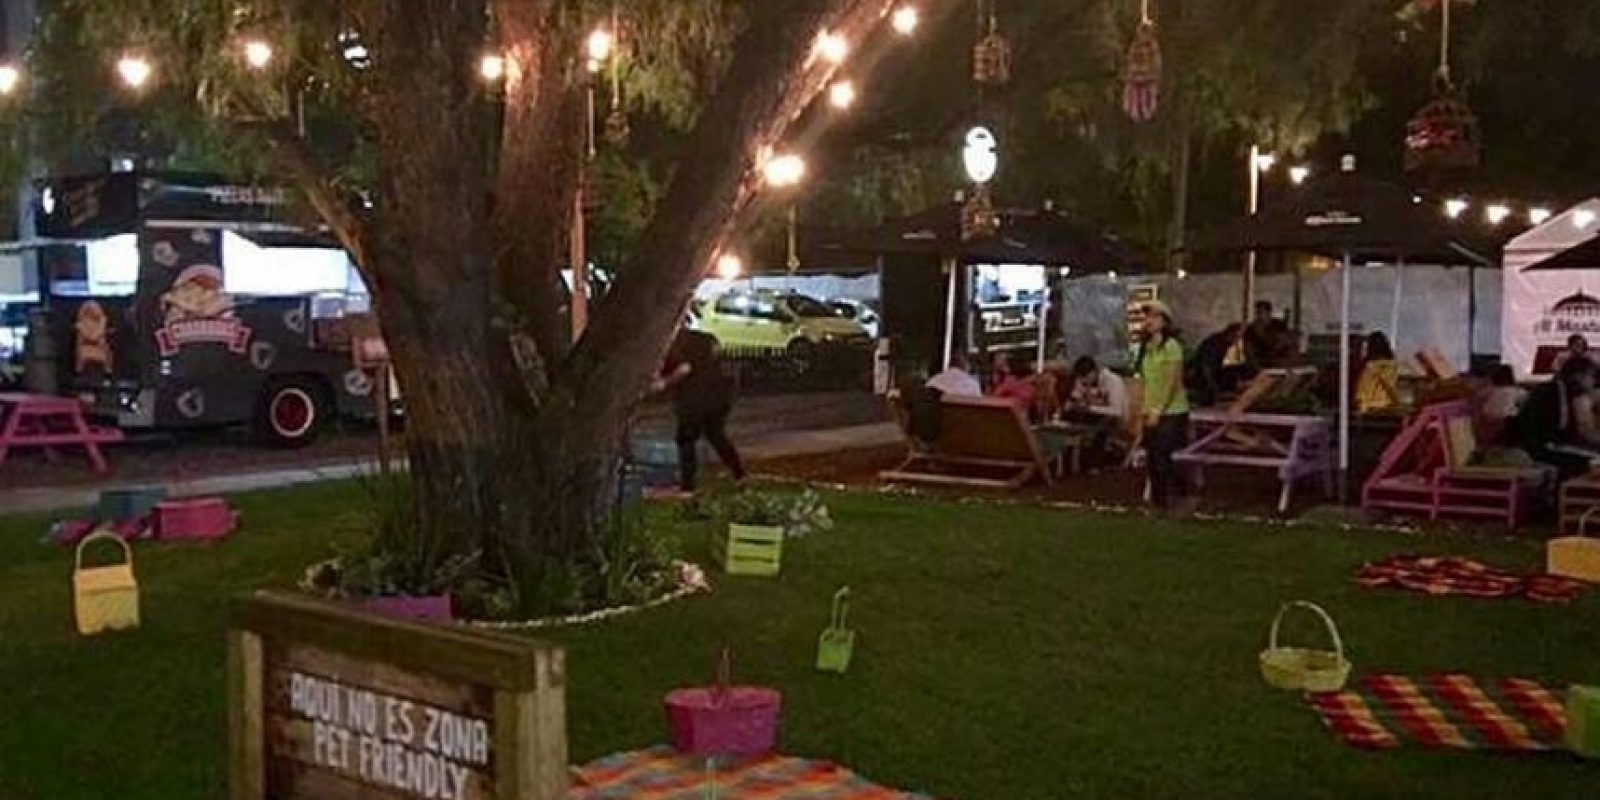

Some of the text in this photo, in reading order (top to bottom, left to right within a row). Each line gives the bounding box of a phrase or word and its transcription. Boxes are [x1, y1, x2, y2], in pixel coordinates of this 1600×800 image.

[313, 719, 469, 800] PET FRIENDLY
[347, 689, 376, 735] NO
[386, 697, 416, 744] ES
[424, 706, 488, 765] ZONA
